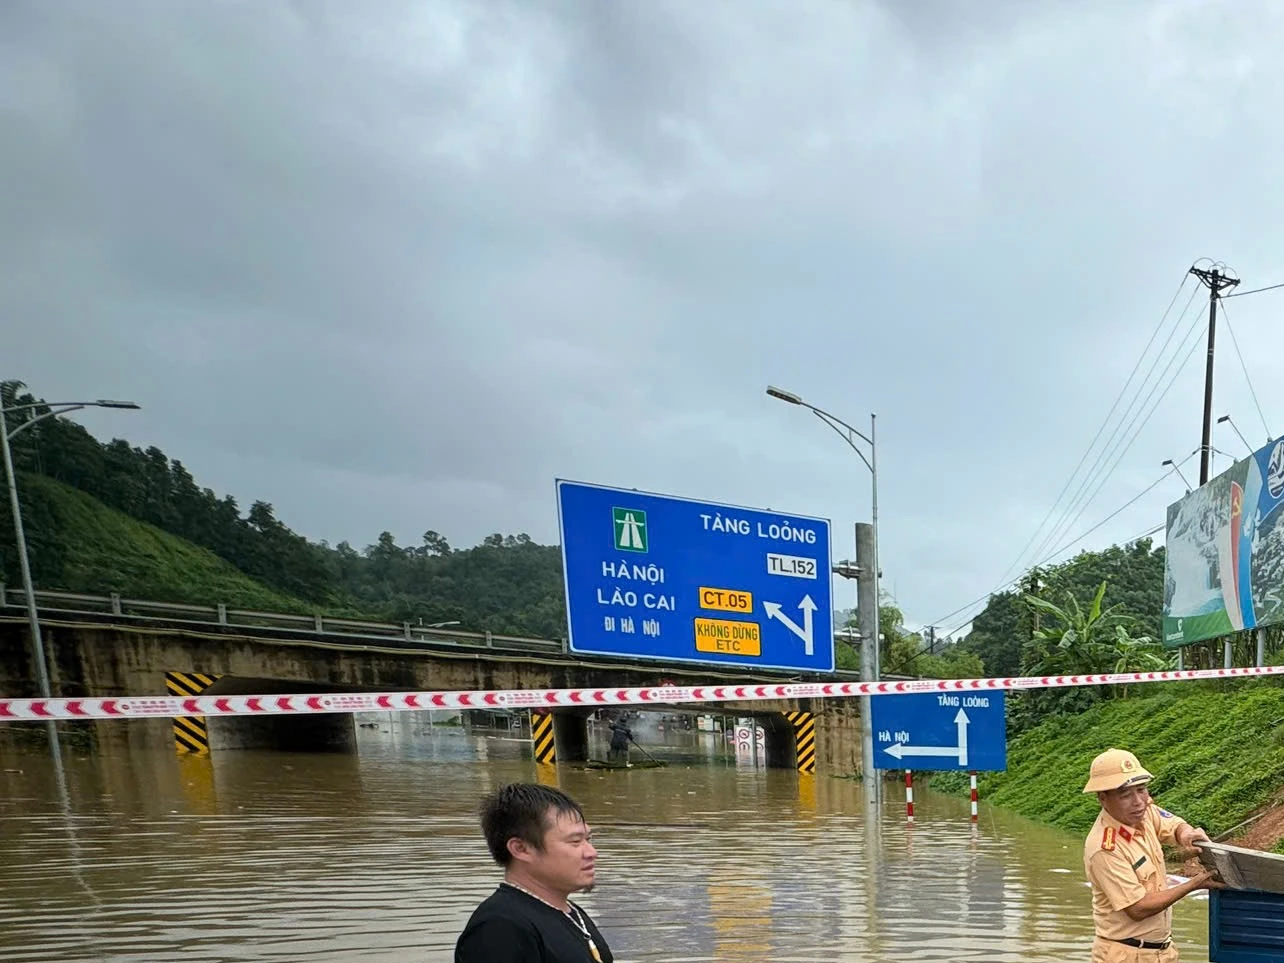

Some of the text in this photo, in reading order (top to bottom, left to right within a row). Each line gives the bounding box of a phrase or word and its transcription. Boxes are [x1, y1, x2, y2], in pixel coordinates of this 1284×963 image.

[757, 520, 817, 544] LOỎNG
[597, 586, 675, 611] LÀO CAI
[704, 591, 747, 608] CT.05
[604, 616, 660, 638] ĐI HÀ NỘI
[697, 622, 758, 641] KHÔNG DỪNG
[716, 639, 741, 651] ETC
[878, 729, 910, 744] HÀ NỘI
